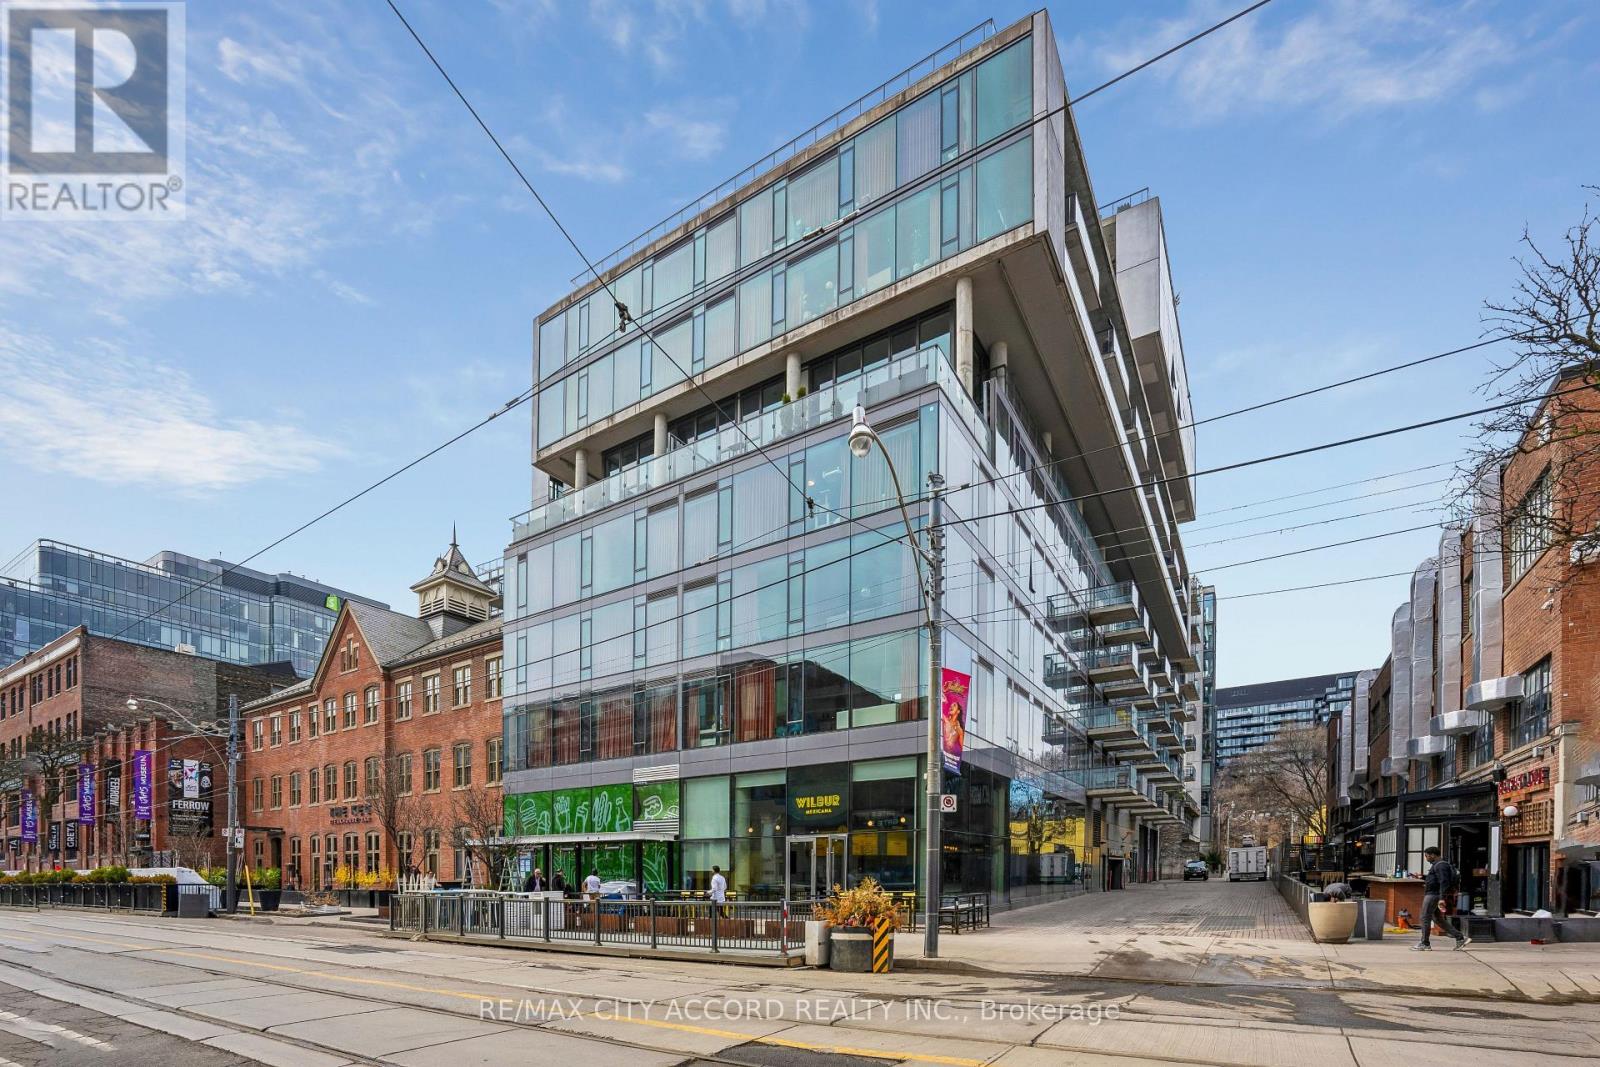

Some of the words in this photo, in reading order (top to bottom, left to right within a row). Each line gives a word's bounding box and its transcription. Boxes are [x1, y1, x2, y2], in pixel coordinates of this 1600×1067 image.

[110, 777, 120, 807] FERROW
[796, 795, 840, 809] WILBUR
[172, 800, 210, 811] FERROW
[66, 822, 75, 848] GRETA
